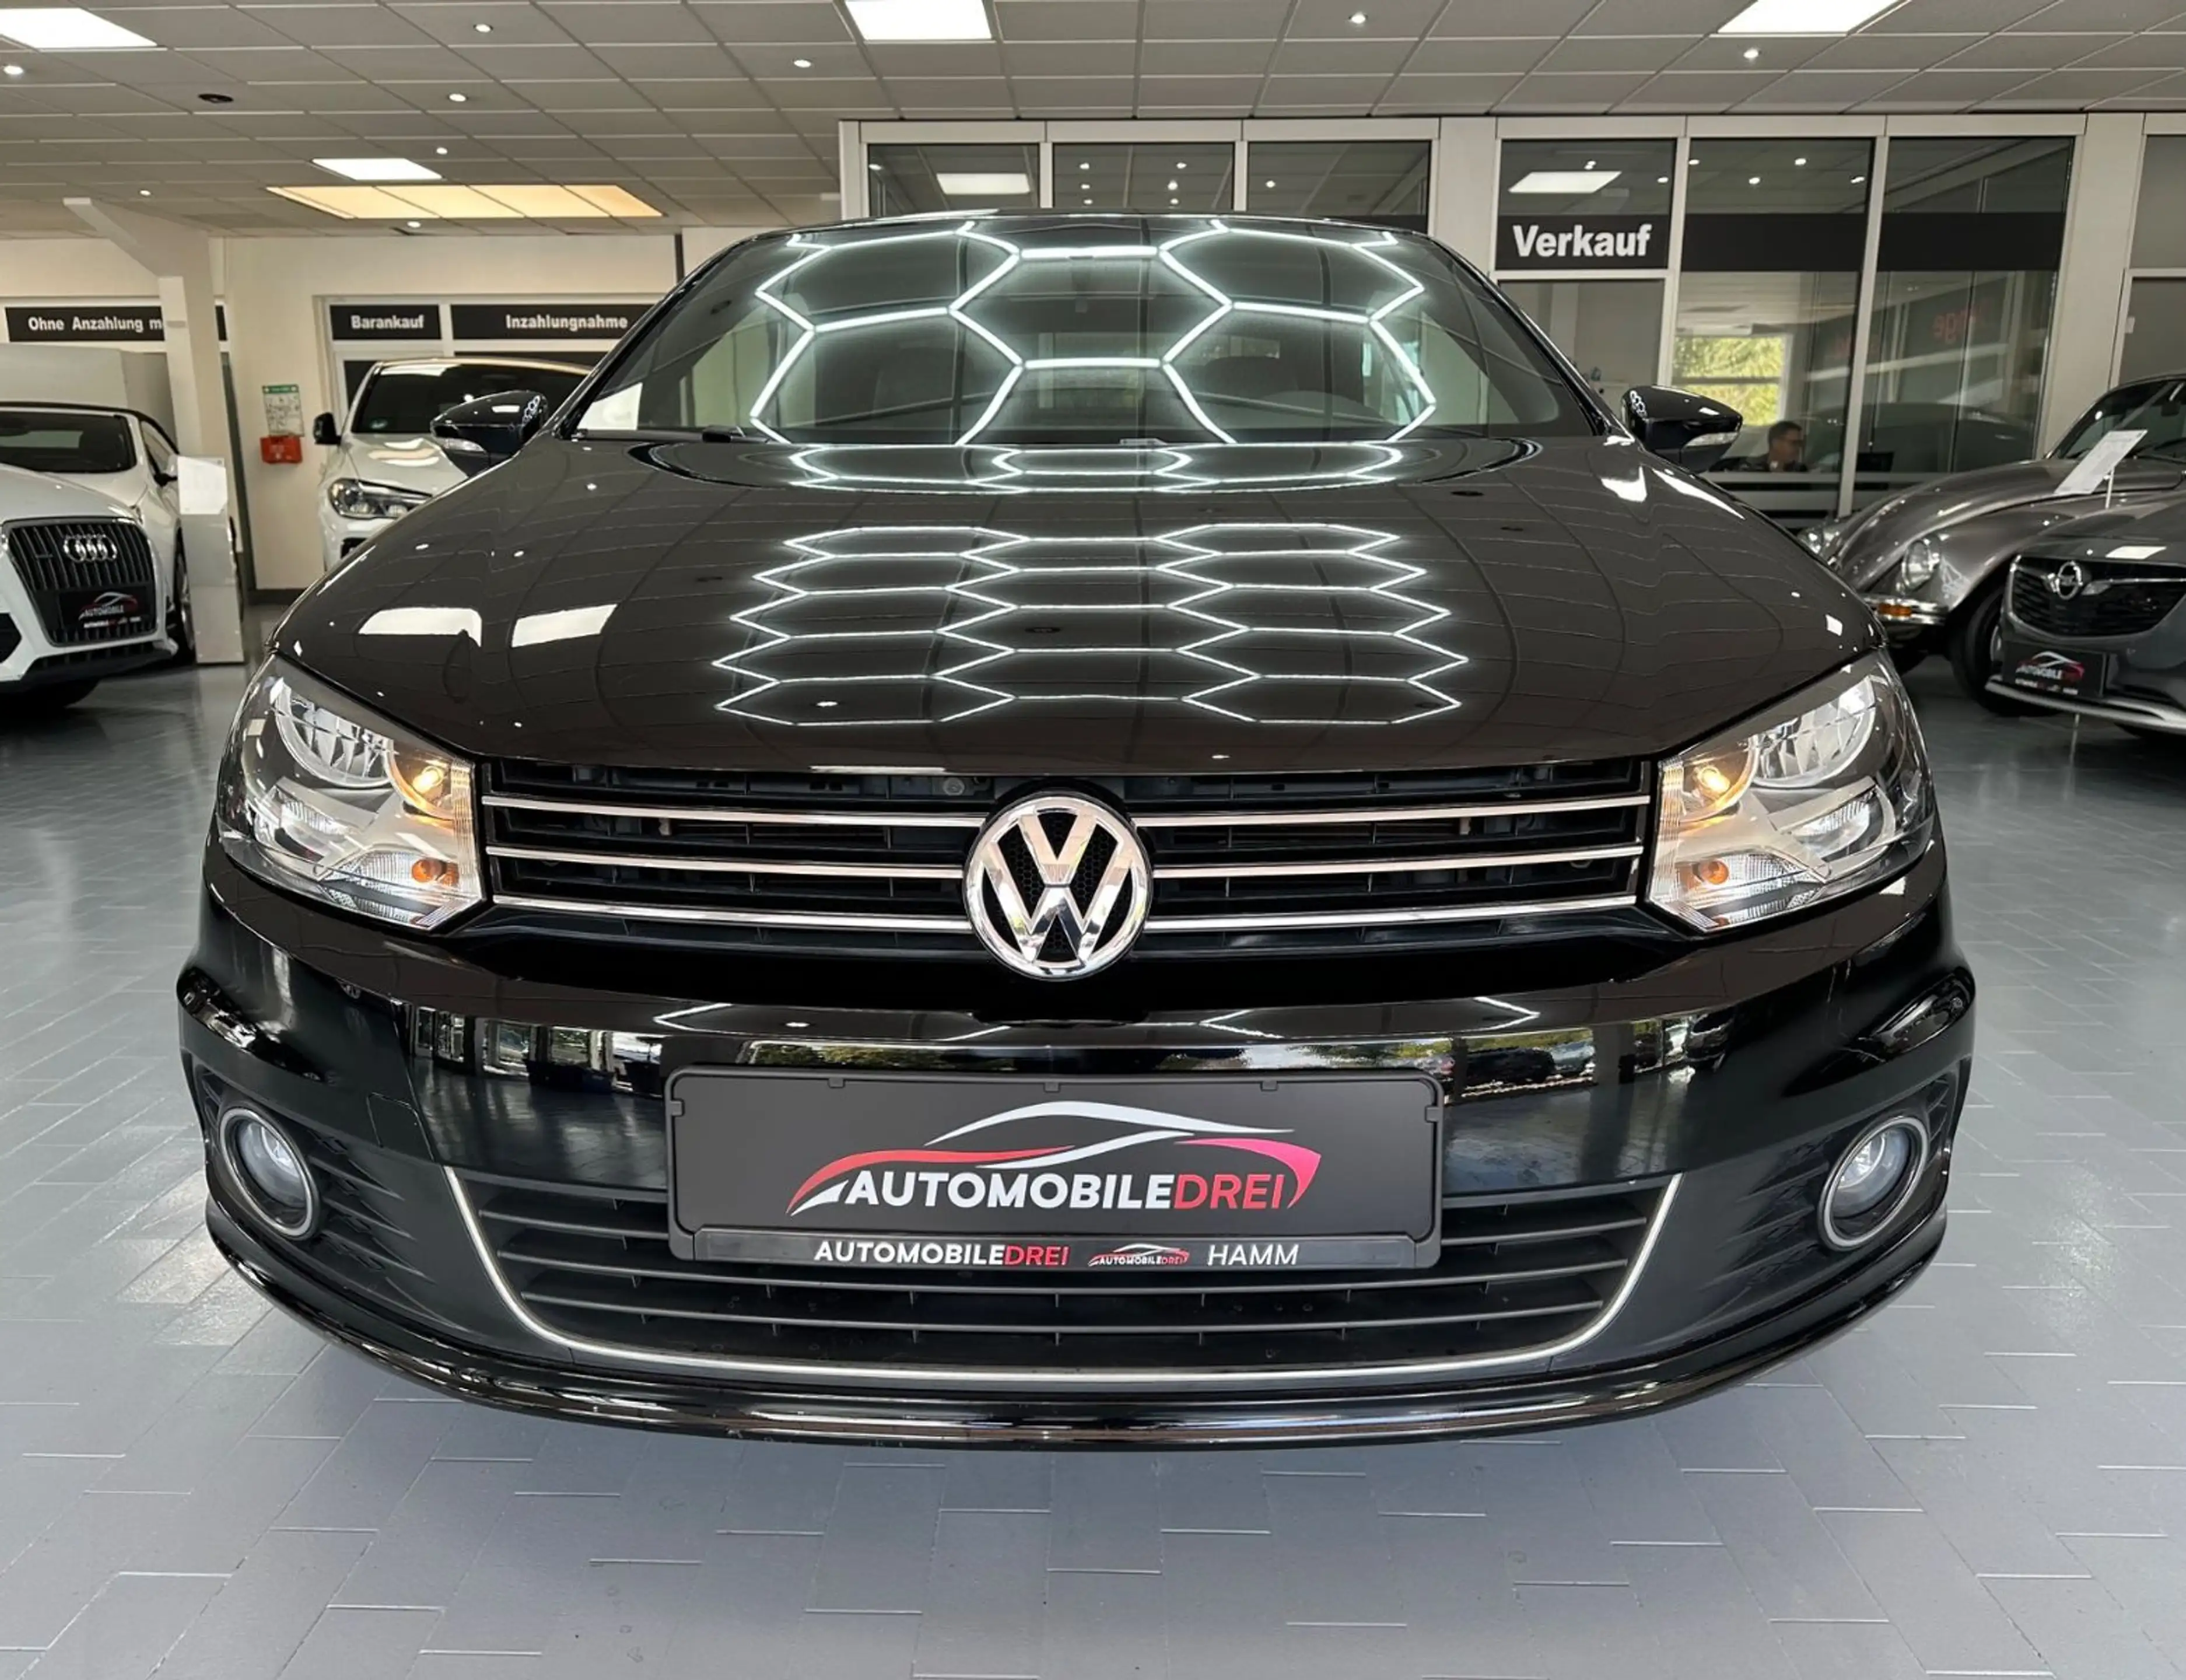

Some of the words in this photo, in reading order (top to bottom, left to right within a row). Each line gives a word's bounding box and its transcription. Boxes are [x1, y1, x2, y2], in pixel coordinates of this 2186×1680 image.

[1512, 223, 1652, 257] Verkauf
[28, 317, 64, 331] Ohne
[72, 316, 143, 333] Anzahlung
[149, 318, 163, 330] m
[351, 314, 424, 329] Barankauf
[506, 314, 628, 331] Inzahlungnahme
[980, 808, 1134, 968] VW
[845, 1170, 1284, 1210] AUTOMOBILEDREI
[814, 1241, 1070, 1266] AUTOMOBILEDREI
[1207, 1244, 1299, 1266] HAMM
